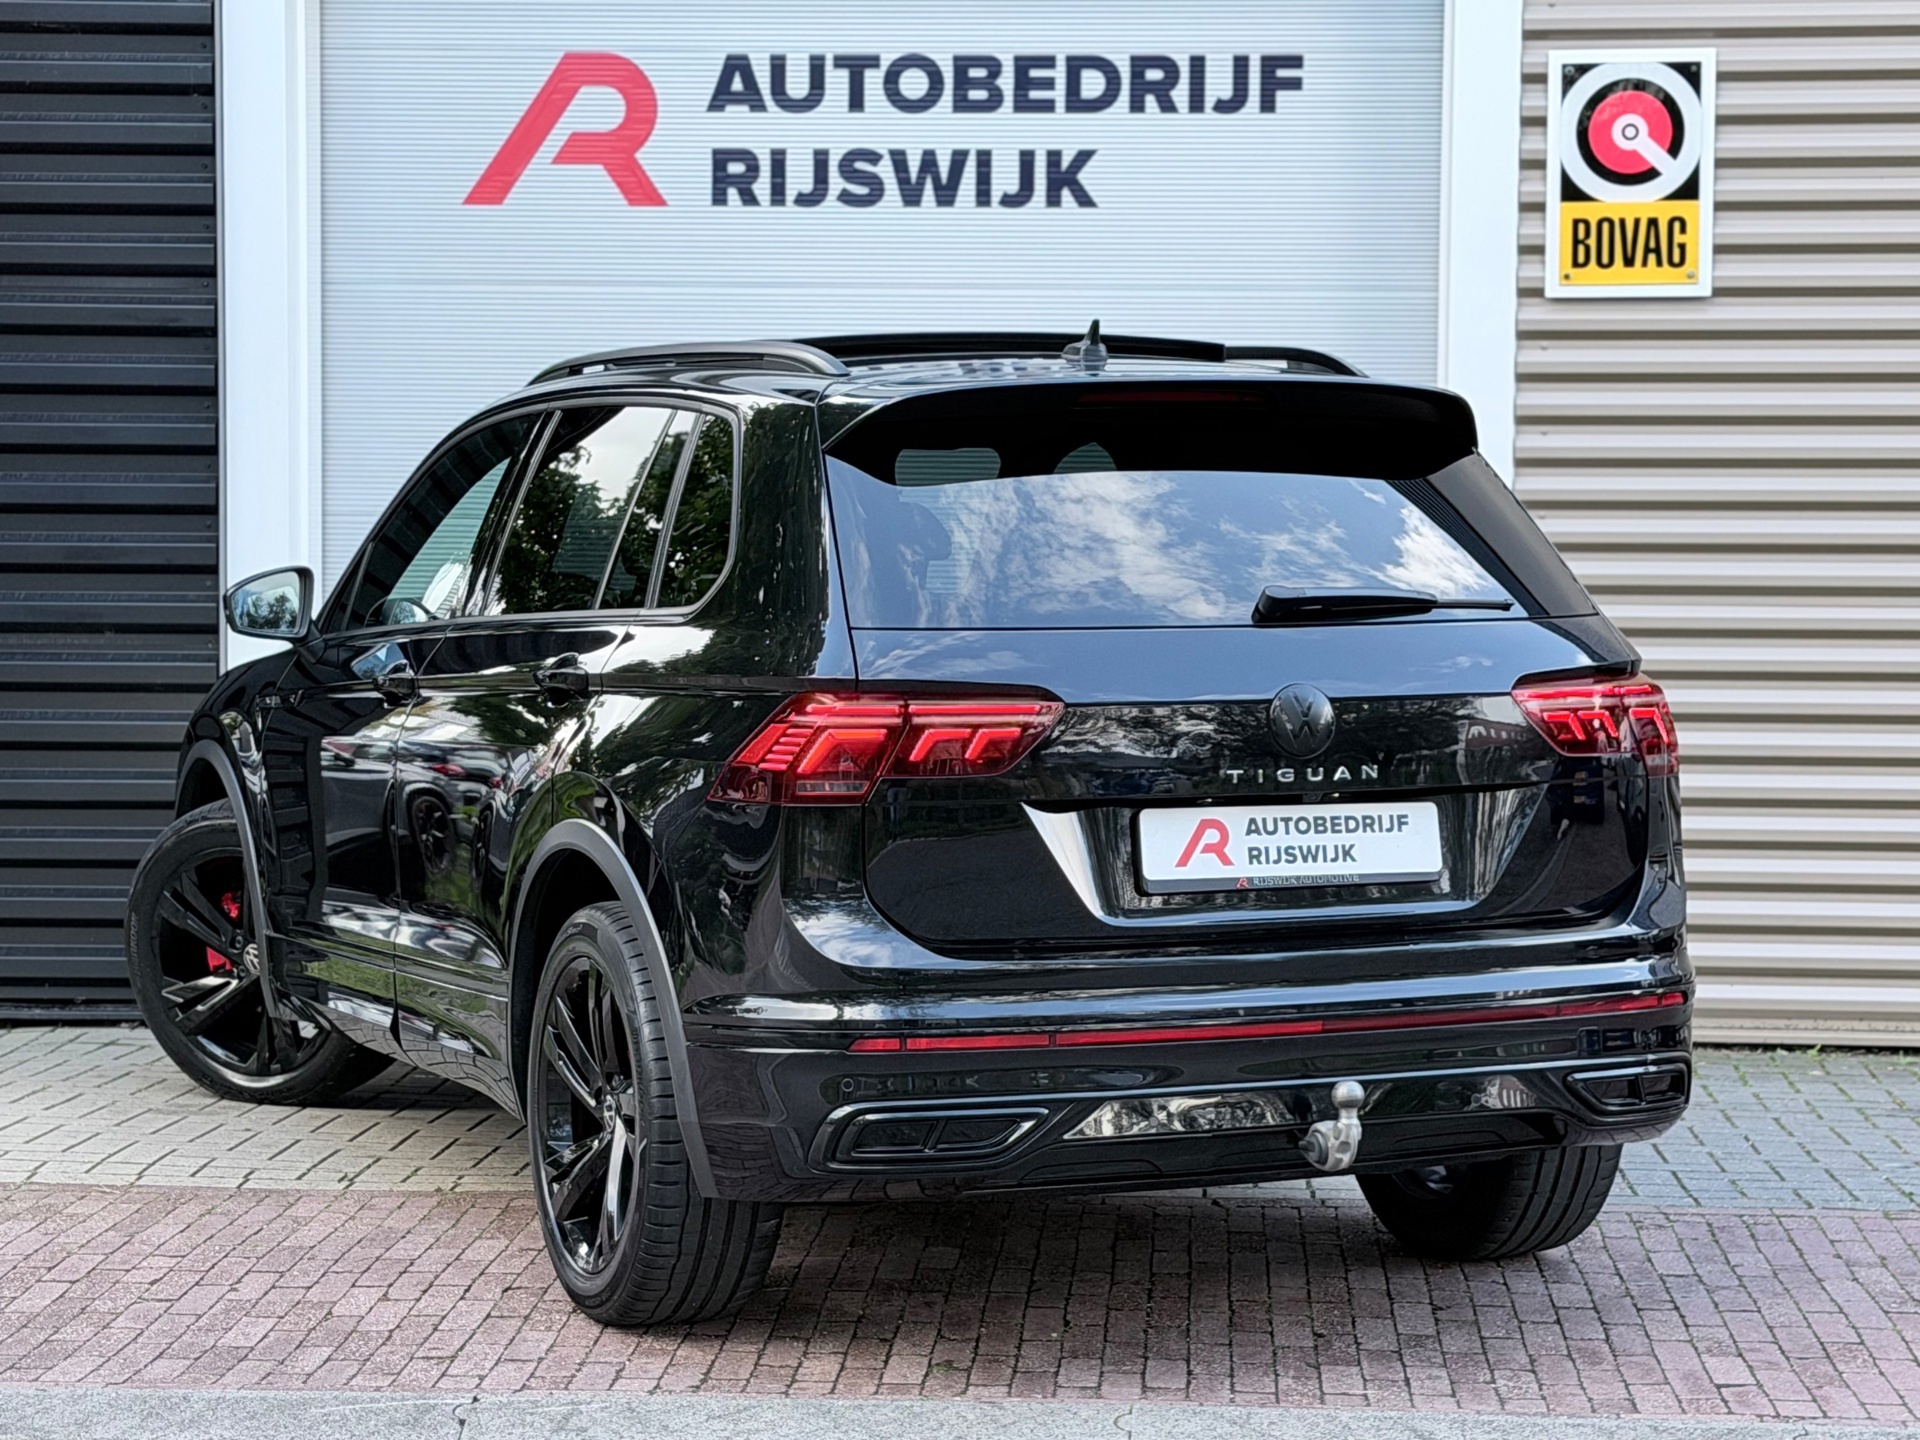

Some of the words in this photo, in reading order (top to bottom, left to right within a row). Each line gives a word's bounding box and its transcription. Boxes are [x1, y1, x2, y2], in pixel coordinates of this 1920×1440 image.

[707, 53, 1304, 115] AUTOBEDRIJF
[711, 148, 1099, 208] RIJSWIJK
[1571, 216, 1688, 269] BOVAG
[1226, 764, 1379, 784] TIGUAN
[1244, 813, 1410, 837] AUTOBEDRIJF
[1247, 843, 1358, 866] RIJSWIJK
